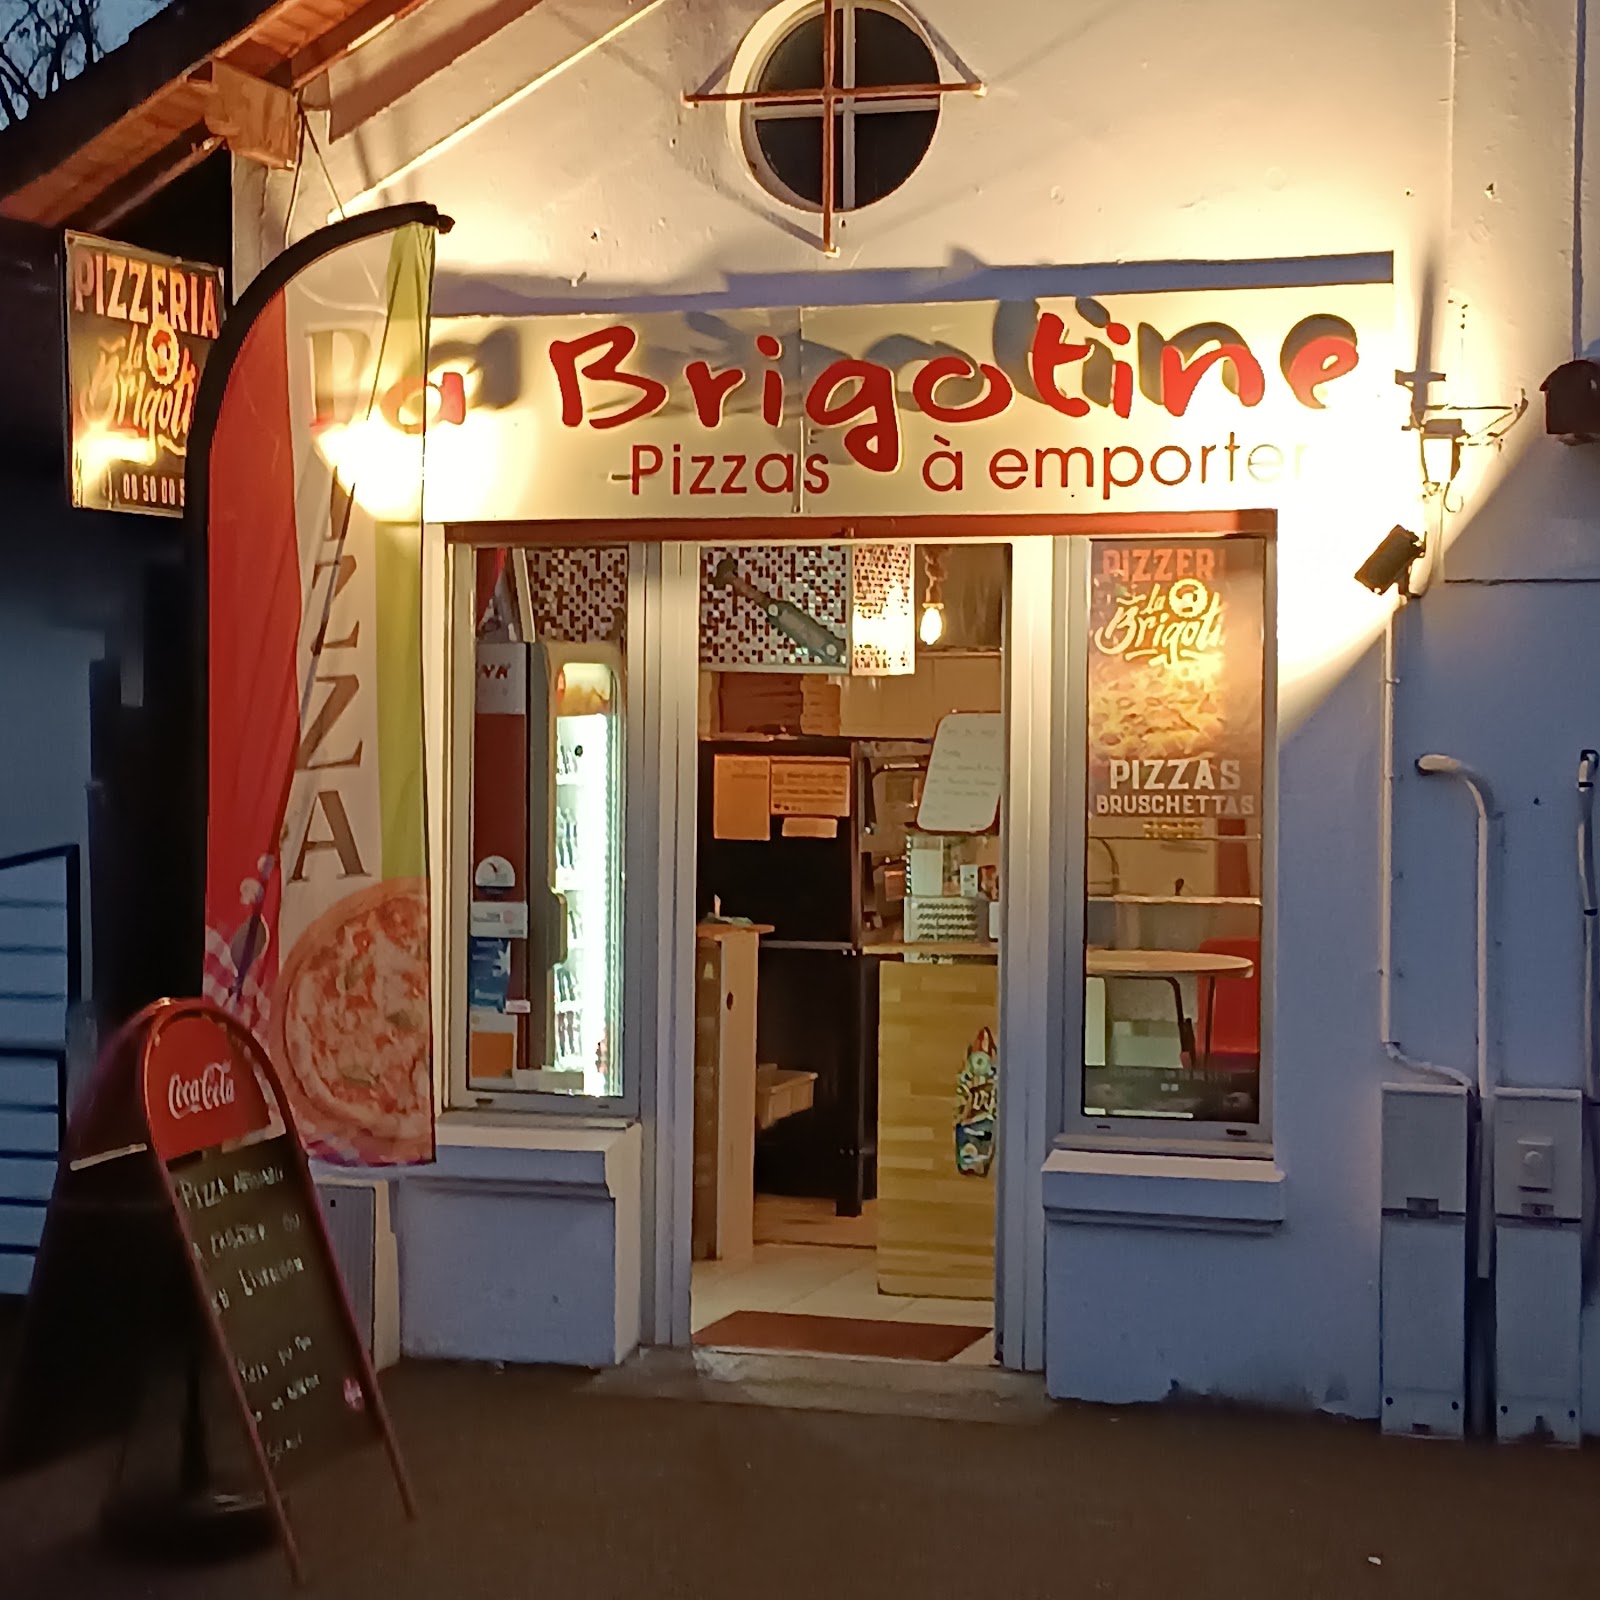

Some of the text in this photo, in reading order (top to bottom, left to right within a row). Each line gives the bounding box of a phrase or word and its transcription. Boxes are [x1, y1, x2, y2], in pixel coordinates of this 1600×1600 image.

[74, 250, 220, 339] PIZZERIA
[549, 312, 1359, 472] Brigotine
[631, 443, 829, 495] Pizzas
[923, 434, 963, 491] à
[1096, 794, 1255, 815] BRUSCHETTAS
[1110, 759, 1241, 790] PIZZAS
